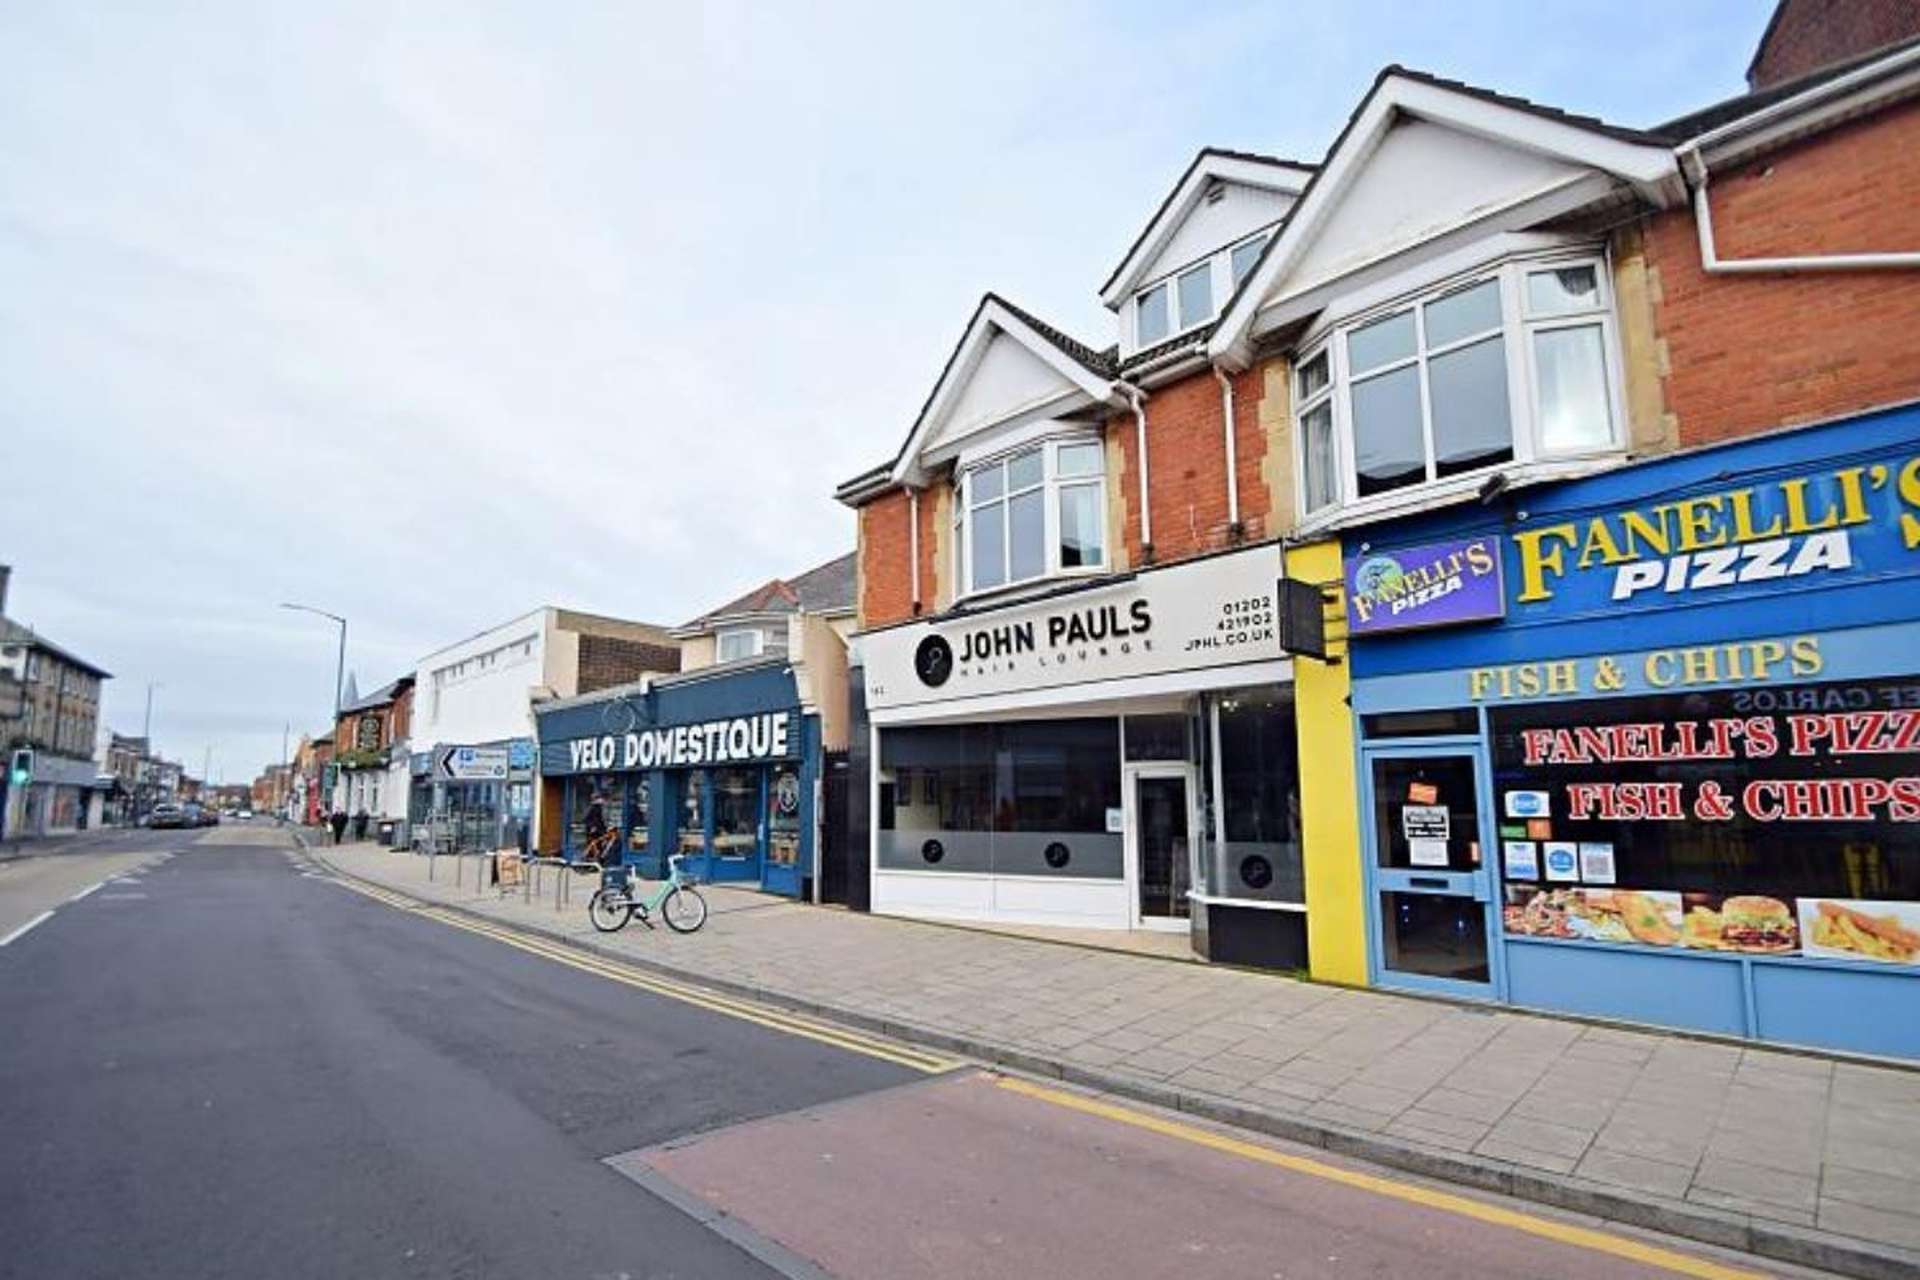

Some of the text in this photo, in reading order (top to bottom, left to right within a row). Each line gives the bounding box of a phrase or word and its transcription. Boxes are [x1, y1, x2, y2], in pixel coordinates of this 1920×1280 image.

[1353, 542, 1494, 623] FANELLI'S
[1612, 530, 1851, 600] PIZZA
[1223, 596, 1270, 615] 01202
[1391, 575, 1462, 615] PIZZA
[959, 599, 1151, 662] JOHN PAULS
[1471, 636, 1823, 700] FISH & CHIPS
[570, 735, 615, 770] VELO
[624, 712, 788, 766] DOMESTIQUE
[1522, 716, 1778, 765] FANELLI'S
[1566, 777, 1920, 822] FISH & CHIPS
